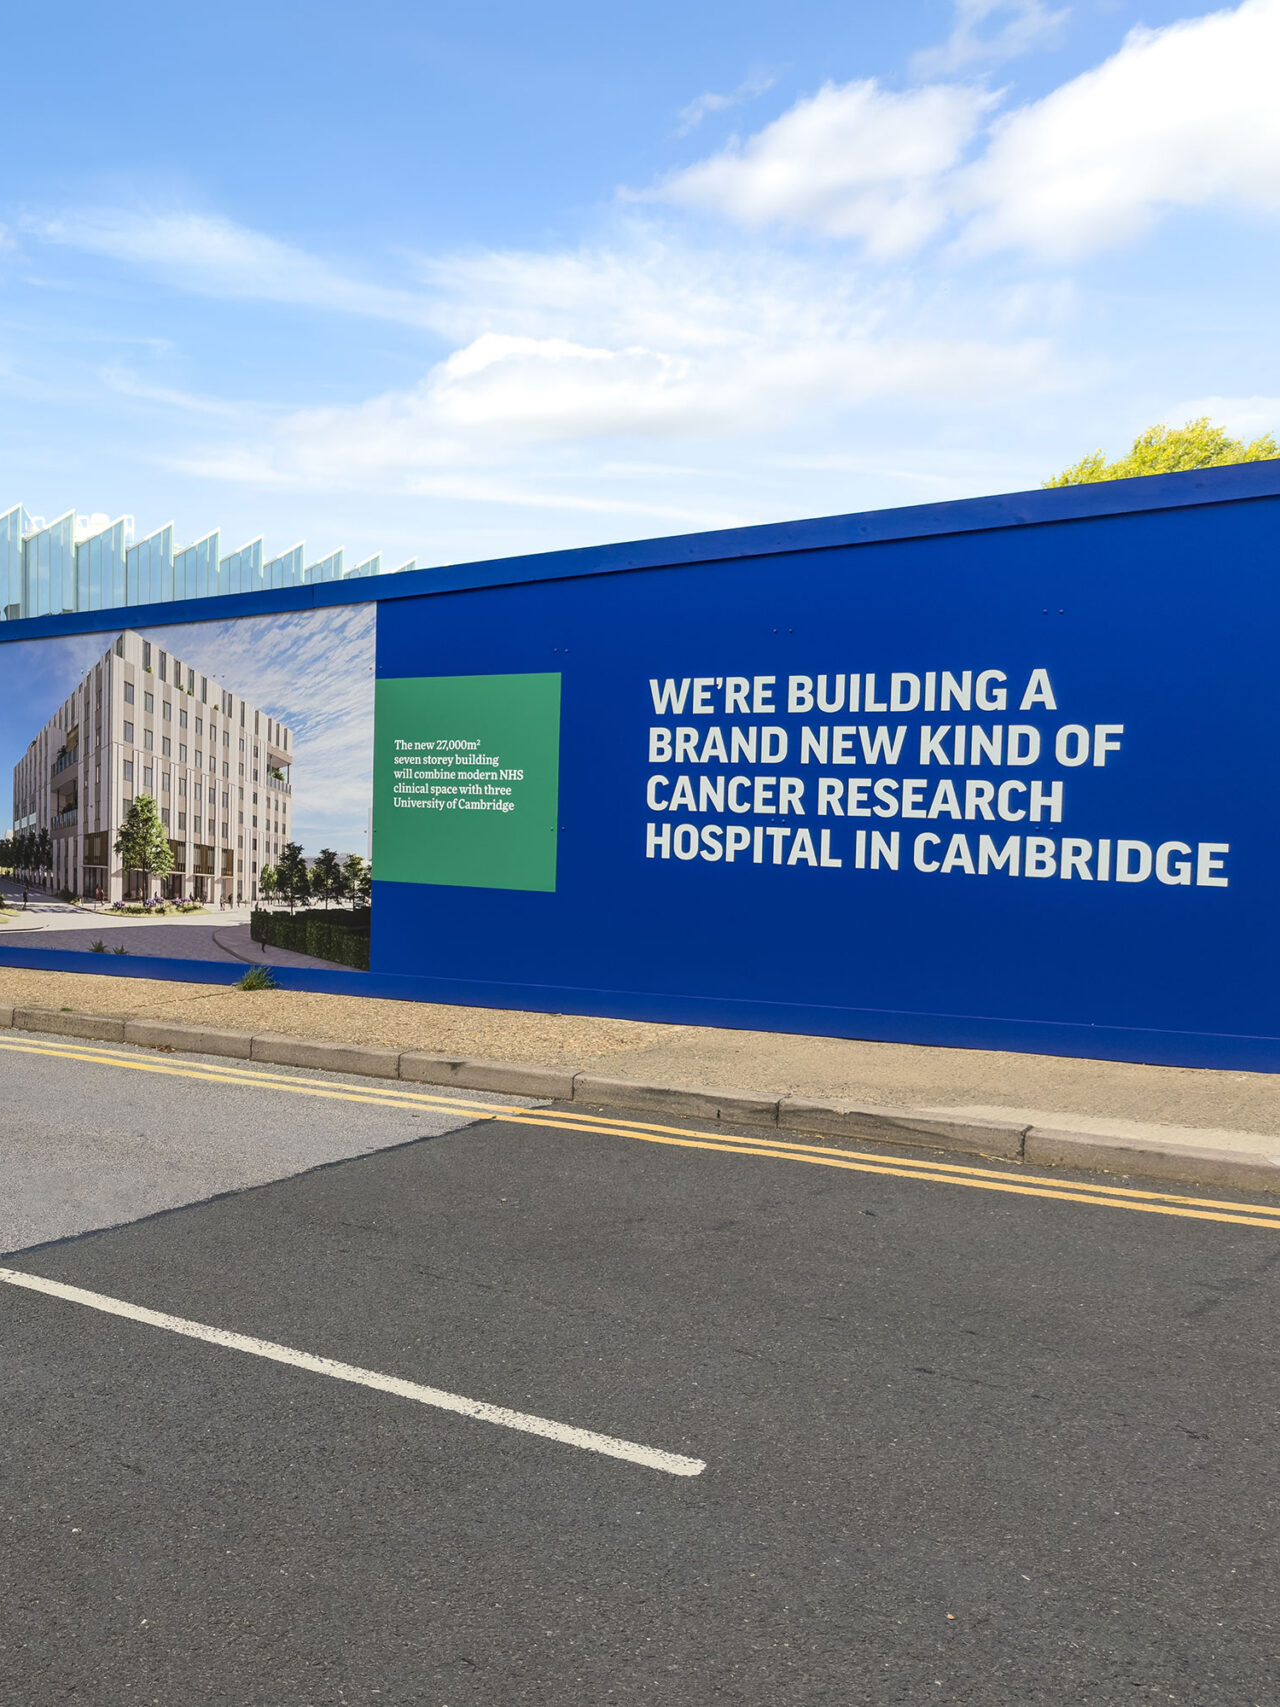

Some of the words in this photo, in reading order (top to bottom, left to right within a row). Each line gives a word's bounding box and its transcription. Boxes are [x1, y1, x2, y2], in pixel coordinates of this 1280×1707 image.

[649, 675, 776, 715] WE’RE
[787, 669, 1008, 714] BUILDING
[1019, 668, 1058, 711] A
[394, 739, 413, 750] The
[414, 741, 435, 750] new
[648, 726, 788, 764] BRAND
[800, 725, 908, 765] NEW
[919, 724, 1041, 766] KIND
[1055, 724, 1124, 767] OF
[393, 755, 421, 765] seven
[422, 754, 454, 767] storey
[455, 754, 499, 768] building
[393, 768, 412, 779] will
[414, 768, 456, 780] combine
[457, 769, 498, 780] modern
[499, 769, 524, 781] NHS
[393, 782, 429, 794] clinical
[430, 785, 457, 796] space
[459, 783, 482, 795] with
[484, 784, 512, 796] three
[393, 797, 445, 811] University
[446, 798, 458, 809] of
[458, 798, 515, 813] Cambridge
[646, 774, 806, 815] CANCER
[817, 777, 1064, 823] RESEARCH
[645, 822, 842, 868] HOSPITAL
[855, 829, 900, 871] IN
[913, 831, 1230, 887] CAMBRIDGE
